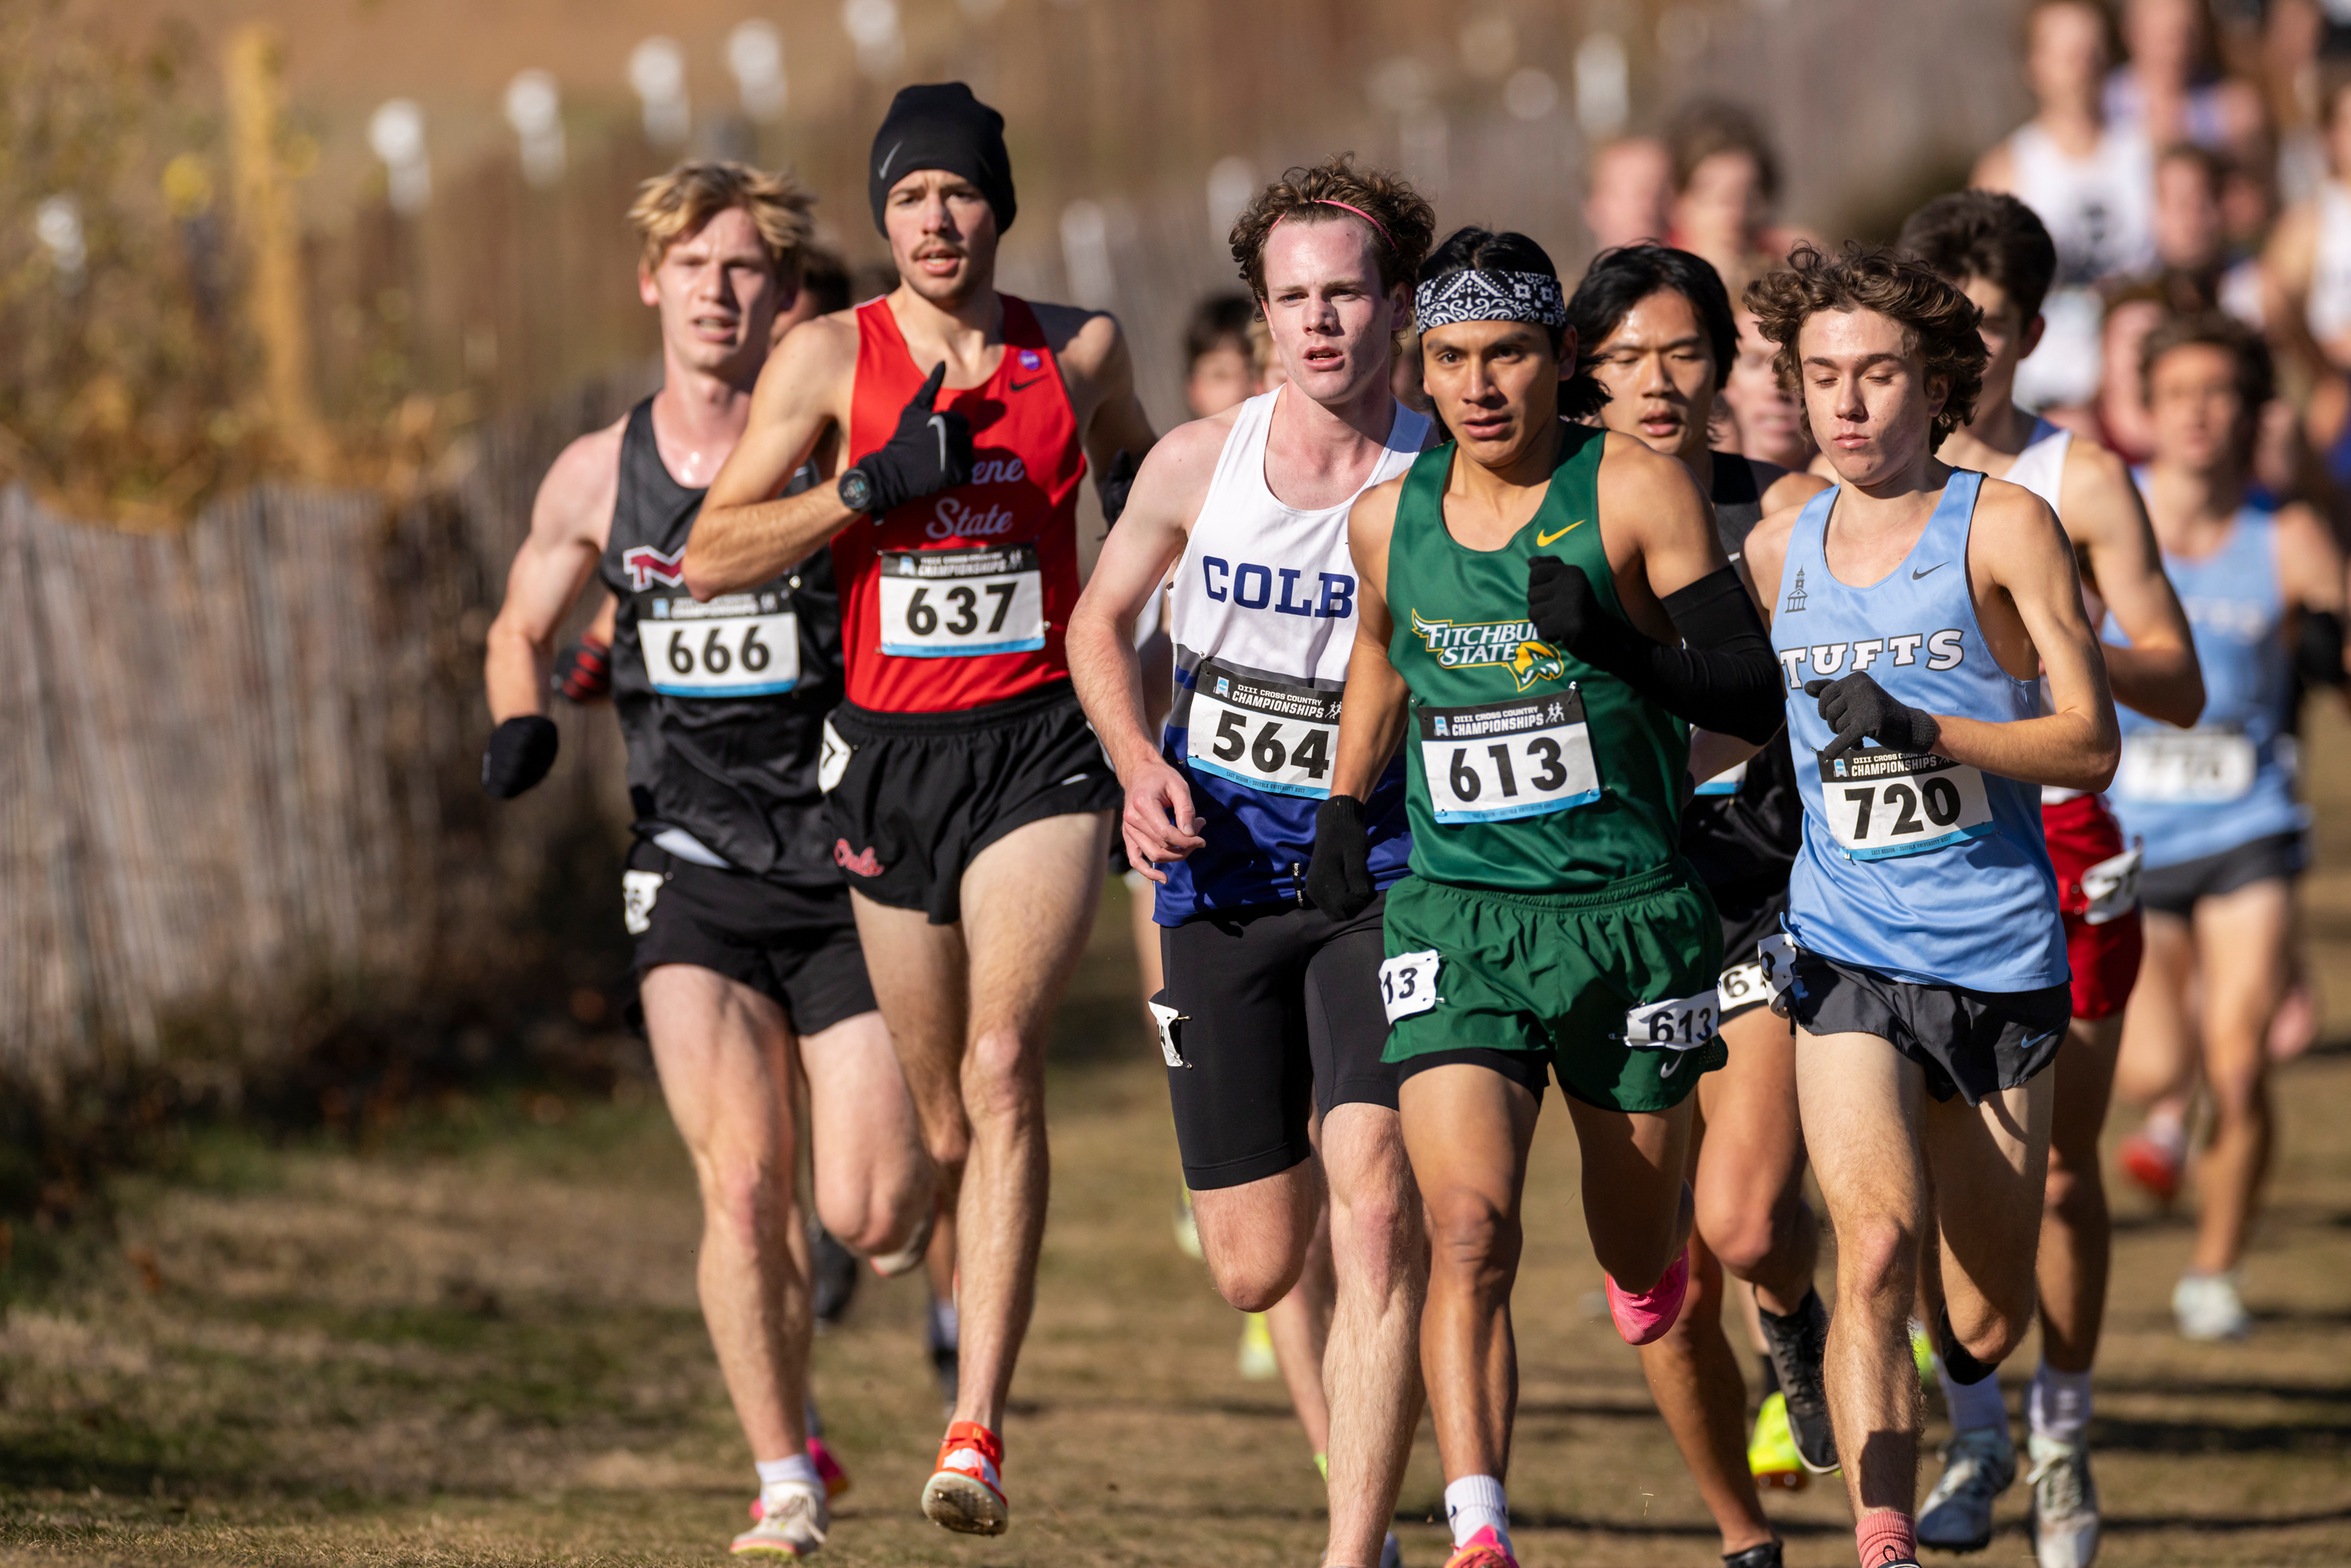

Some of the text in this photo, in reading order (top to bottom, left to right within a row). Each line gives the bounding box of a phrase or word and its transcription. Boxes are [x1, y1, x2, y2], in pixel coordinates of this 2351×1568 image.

[971, 458, 1025, 486] ene
[926, 497, 1013, 539] State
[1203, 555, 1355, 619] COLB
[906, 582, 1019, 636] 637
[668, 624, 770, 675] 666
[1415, 619, 1538, 648] FITCHBU
[1440, 642, 1520, 666] STATE
[1779, 628, 1965, 690] TUFTS
[1232, 690, 1325, 718] CHAMPIONSHIPS
[1237, 684, 1322, 706] DIII CROSS COUNTRY
[1452, 713, 1544, 737] CHAMPIONSHIPS
[1453, 706, 1539, 723] DIII CROSS COUNTRY
[1213, 709, 1330, 779] 564
[1853, 756, 1872, 764] DIII
[1873, 753, 1897, 762] CROSS
[1449, 737, 1567, 802] 613
[1851, 756, 1937, 777] CHAMPIONSHIPS
[1844, 777, 1961, 840] 720
[1383, 967, 1418, 1005] 13
[1649, 1008, 1712, 1043] 613
